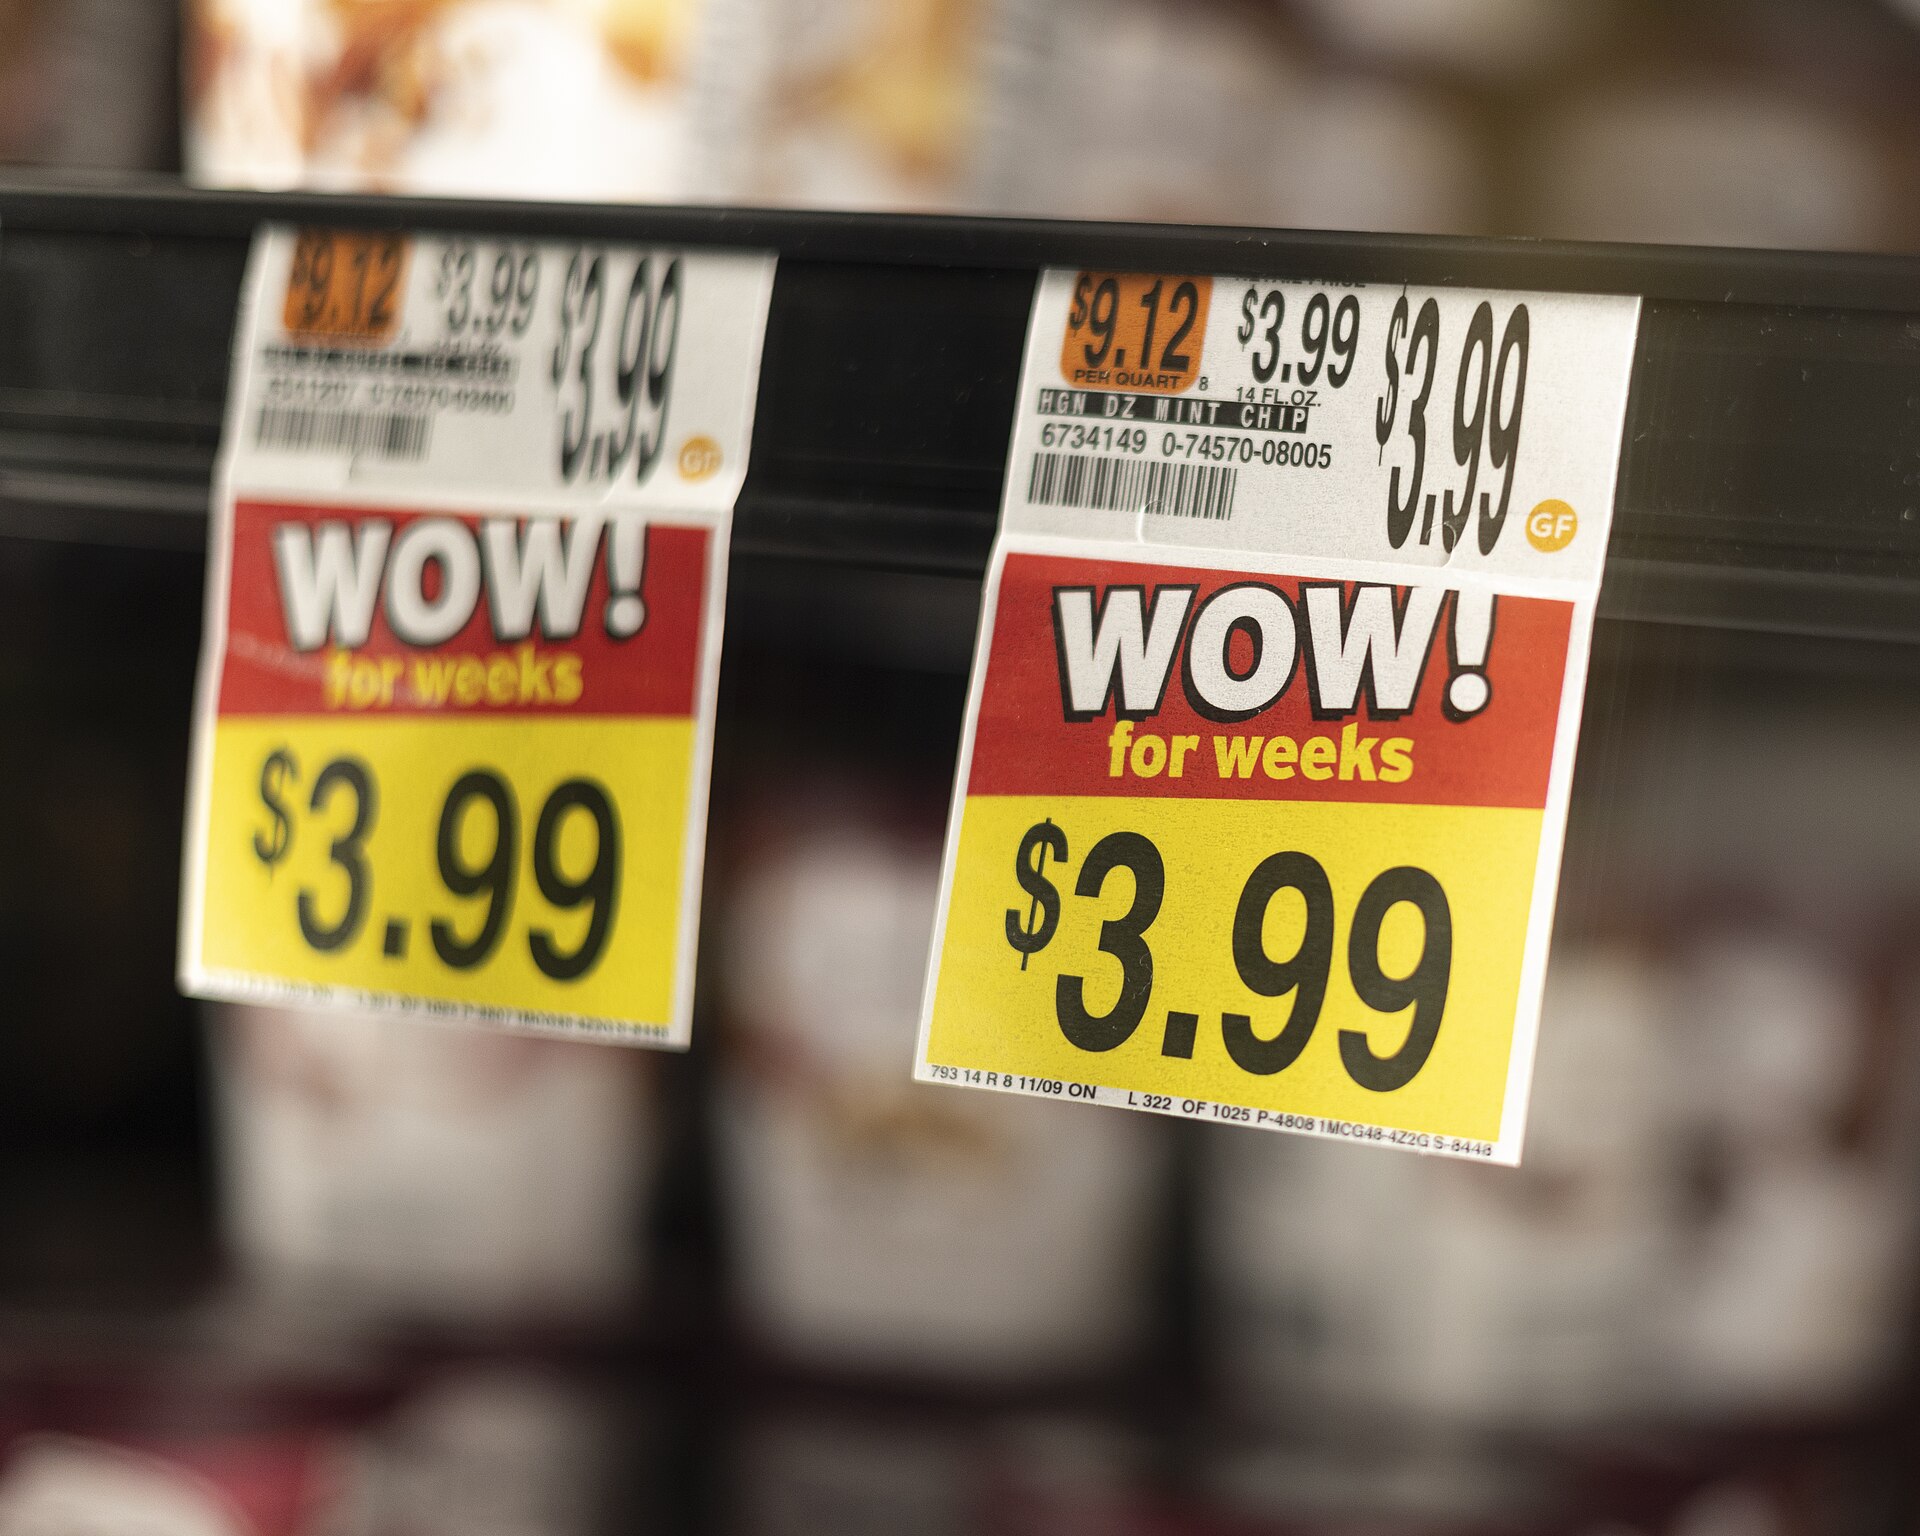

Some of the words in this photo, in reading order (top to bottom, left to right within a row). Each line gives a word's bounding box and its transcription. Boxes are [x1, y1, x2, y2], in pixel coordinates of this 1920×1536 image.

[1069, 275, 1199, 373] $9.12
[1237, 284, 1360, 389] $3.99
[1040, 390, 1085, 415] HGN
[1104, 396, 1136, 418] DZ
[1155, 399, 1221, 425] MINT
[1240, 405, 1307, 431] CHIP
[1074, 369, 1112, 385] PER
[1116, 371, 1181, 389] QUART
[1237, 386, 1256, 402] 14
[1041, 423, 1147, 453] 6734149
[1162, 432, 1332, 469] 0-74570-08005
[1376, 279, 1529, 556] $3.99
[1530, 512, 1574, 539] GF
[273, 516, 650, 652] WOW!
[325, 646, 404, 709] for
[413, 643, 583, 707] weeks
[1052, 581, 1498, 723] WOW!
[1108, 720, 1200, 778] for
[1213, 722, 1415, 783] weeks
[252, 744, 624, 984] $3.99
[1005, 817, 1453, 1092] $3.99
[931, 1065, 957, 1081] 793
[964, 1069, 981, 1084] 14
[986, 1072, 998, 1086] R
[1003, 1074, 1013, 1088] 8
[1019, 1076, 1063, 1095] 11/09
[1068, 1082, 1097, 1099] ON
[1128, 1091, 1138, 1106] L
[1143, 1094, 1172, 1110] 322
[1182, 1099, 1207, 1115] OF
[1213, 1103, 1251, 1121] 1025
[1257, 1109, 1315, 1131] P-4808
